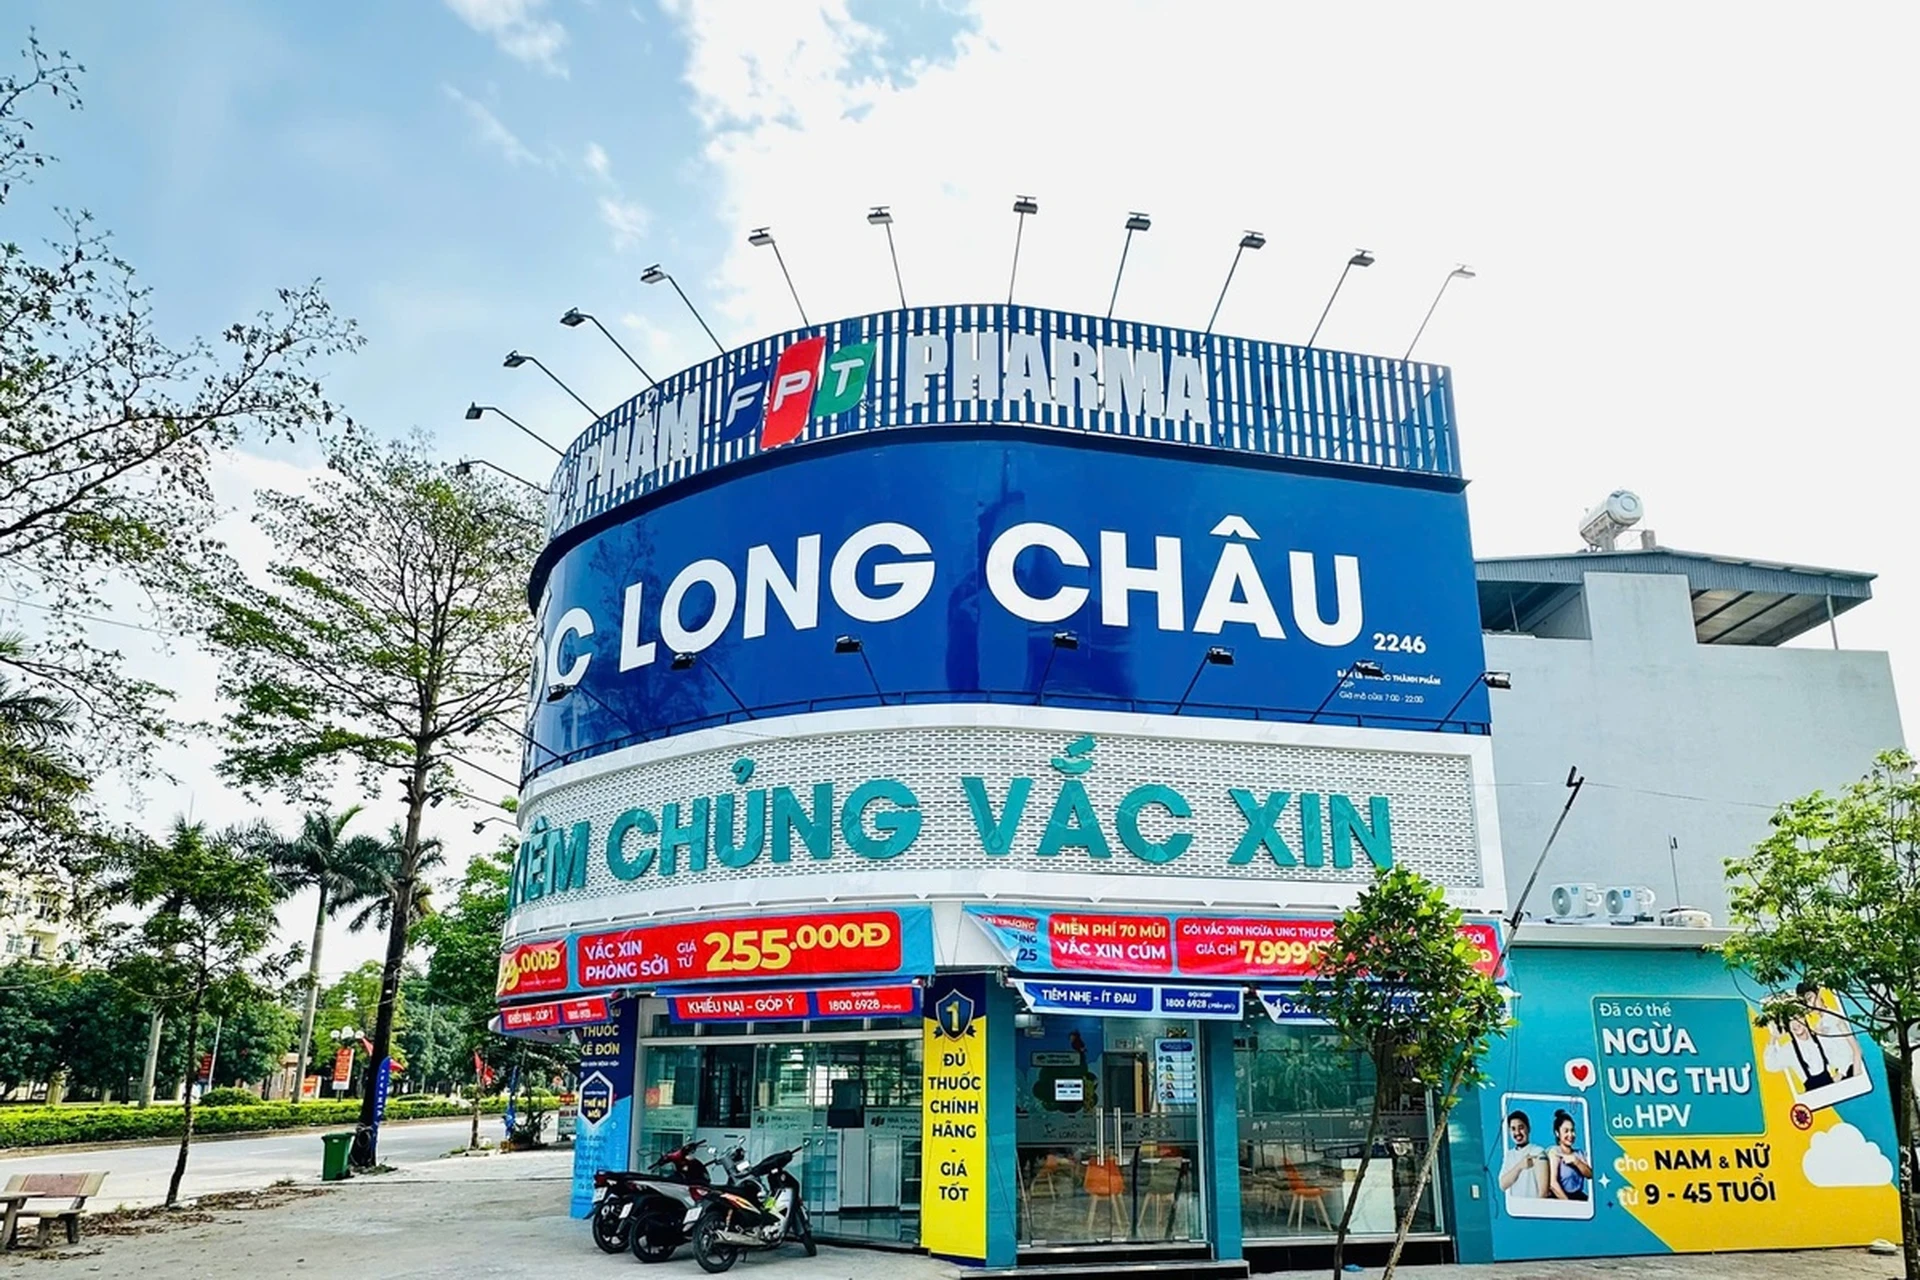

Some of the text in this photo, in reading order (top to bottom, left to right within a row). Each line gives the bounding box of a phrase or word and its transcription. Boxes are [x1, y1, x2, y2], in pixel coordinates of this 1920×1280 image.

[904, 331, 1210, 425] PHARMA
[619, 522, 935, 673] LONG
[985, 514, 1365, 647] CHÂU
[1373, 632, 1427, 653] 2246
[606, 757, 923, 881] CHỦNG
[961, 735, 1194, 865] VẮC
[1227, 788, 1395, 869] XIN
[1053, 918, 1166, 938] MIỄN PHÍ 70 MŨI
[1183, 923, 1201, 935] GÓI
[1203, 922, 1225, 935] VẮC
[1226, 926, 1244, 936] XIN
[1246, 924, 1273, 937] NGỪA
[1275, 927, 1297, 938] UNG
[1298, 926, 1319, 938] THƯ
[585, 939, 643, 960] VẮC XIN
[677, 939, 697, 968] GIÁ TỪ
[703, 922, 891, 972] 255.000Đ
[1056, 935, 1166, 960] VẮC XIN CÚM
[1196, 941, 1216, 955] GIÁ
[1217, 940, 1237, 955] CHỈ
[585, 956, 669, 981] PHÒNG SỞI
[687, 997, 721, 1013] KHIẾU
[723, 1000, 745, 1016] NẠI
[755, 997, 784, 1012] GÓP
[786, 995, 794, 1010] Ý
[828, 1001, 852, 1011] 1800
[854, 999, 881, 1010] 6928
[1042, 986, 1067, 1001] TIÊM
[1069, 990, 1092, 1005] NHẸ
[1101, 988, 1112, 1003] ÍT
[1113, 992, 1137, 1004] ĐAU
[1165, 998, 1185, 1007] 1800
[1187, 999, 1207, 1009] 6928
[945, 1001, 960, 1032] 1
[1600, 1001, 1672, 1017] Đã có thể
[1602, 1021, 1698, 1054] NGỪA
[595, 1041, 621, 1056] ĐƠN
[943, 1048, 966, 1067] ĐỦ
[928, 1072, 982, 1090] THUỐC
[1607, 1062, 1752, 1095] UNG THƯ
[930, 1097, 979, 1114] CHÍNH
[1612, 1103, 1692, 1129] do HPV
[932, 1121, 977, 1139] HÃNG
[940, 1158, 968, 1177] GIÁ
[1613, 1143, 1771, 1172] cho NAM & NỮ
[939, 1182, 969, 1201] TỐT
[1644, 1184, 1660, 1205] 9
[1682, 1182, 1713, 1203] 45
[1716, 1172, 1776, 1202] TUỔI
